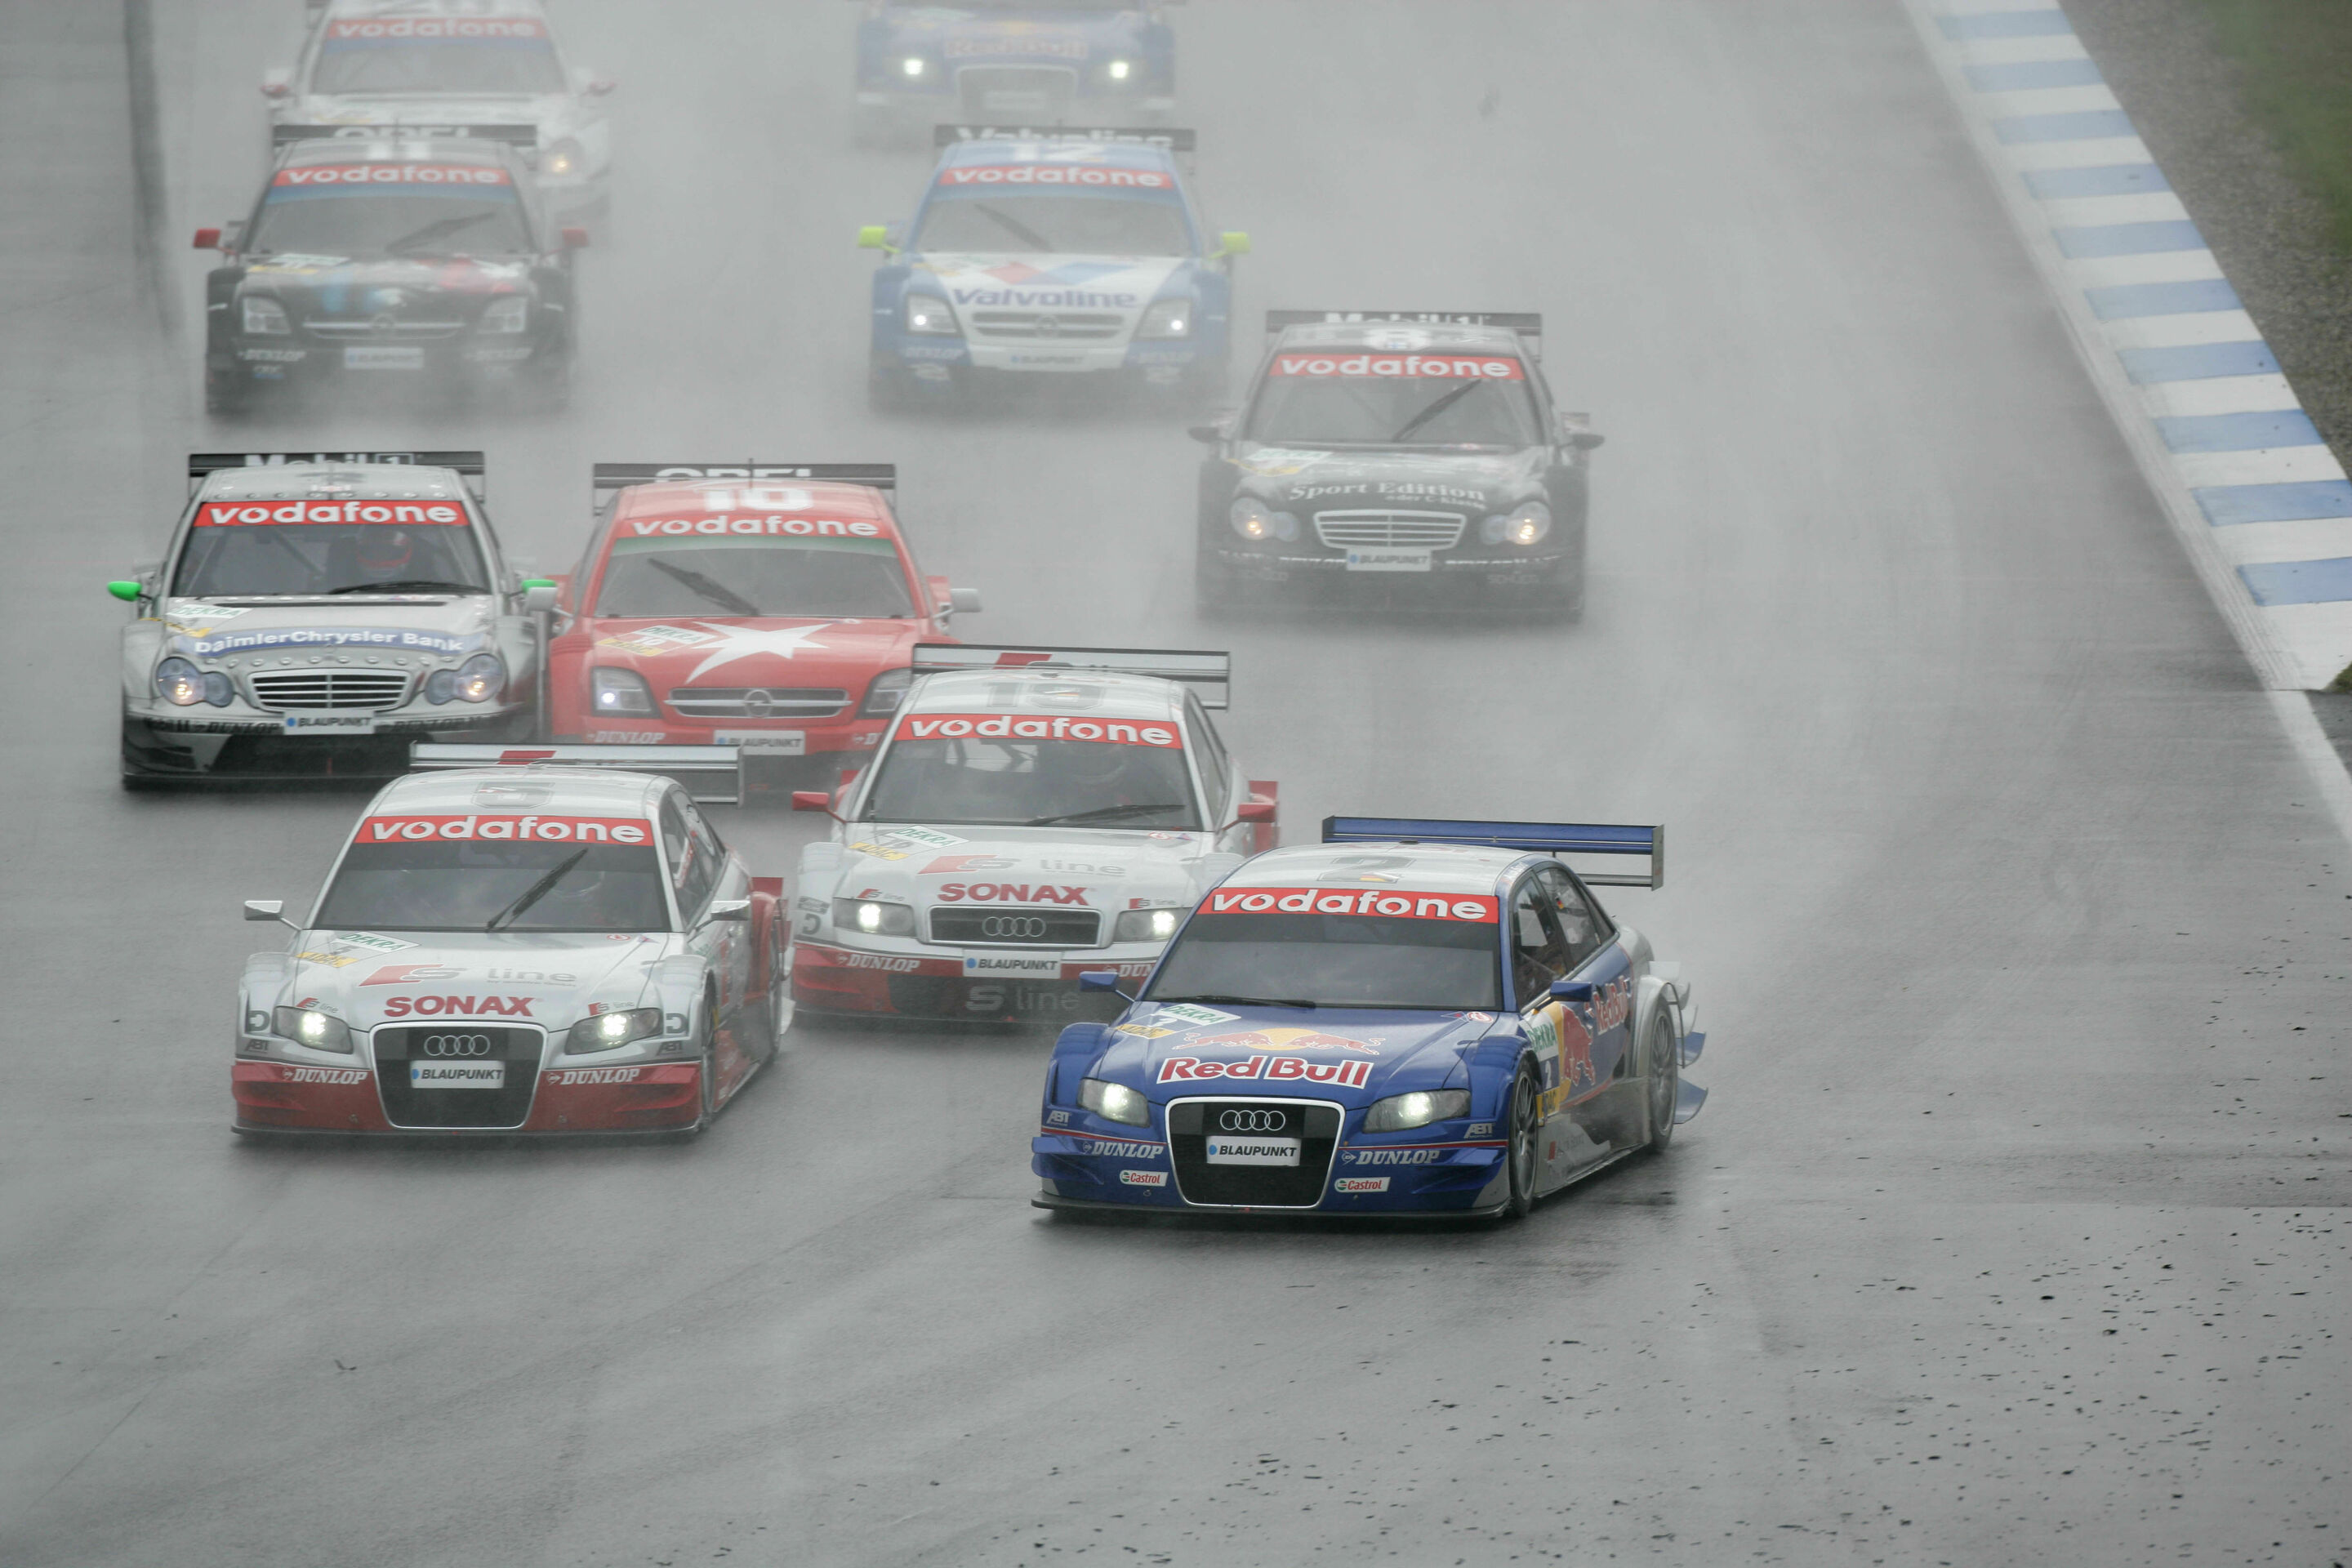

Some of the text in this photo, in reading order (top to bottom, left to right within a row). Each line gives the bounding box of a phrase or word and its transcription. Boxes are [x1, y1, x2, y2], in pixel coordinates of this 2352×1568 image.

[336, 19, 536, 38] vodafone
[287, 166, 501, 184] vodafone
[951, 166, 1164, 188] vodafone
[953, 288, 1138, 309] Valvoline
[1280, 355, 1511, 377] vodafone
[702, 488, 815, 512] 10
[1288, 482, 1486, 502] Sport Edition
[210, 501, 458, 524] vodafone
[632, 515, 880, 536] vodafone
[1360, 554, 1430, 565] BLAUPUNKT
[194, 630, 466, 653] DaimlerChrysler Bank
[639, 626, 702, 643] DEKRA
[296, 715, 373, 728] BLAUPUNKT
[911, 715, 1174, 745] vodafone
[593, 732, 667, 746] DUNLOP
[372, 817, 645, 843] vodafone
[894, 828, 956, 846] DEKRA
[1040, 859, 1125, 875] line
[938, 883, 1091, 906] SONAX
[1213, 889, 1487, 920] vodafone
[339, 933, 407, 950] DEKRA
[846, 952, 921, 972] DUNLOP
[978, 958, 1058, 971] BLAUPUNKT
[488, 968, 577, 982] line
[966, 984, 1080, 1011] S line
[384, 996, 536, 1018] SONAX
[1161, 1005, 1226, 1022] DEKRA
[247, 1040, 270, 1051] ABT
[657, 1040, 684, 1053] ABT
[292, 1068, 368, 1085] DUNLOP
[421, 1069, 503, 1080] BLAUPUNKT
[560, 1068, 640, 1085] DUNLOP
[1159, 1057, 1372, 1087] Red Bull
[1046, 1110, 1072, 1124] ABT
[1464, 1123, 1494, 1137] ABT
[1091, 1141, 1165, 1159] DUNLOP
[1218, 1145, 1297, 1158] BLAUPUNKT
[1356, 1150, 1441, 1165] DUNLOP
[1129, 1172, 1161, 1185] Castrol
[1348, 1178, 1383, 1191] Castrol
